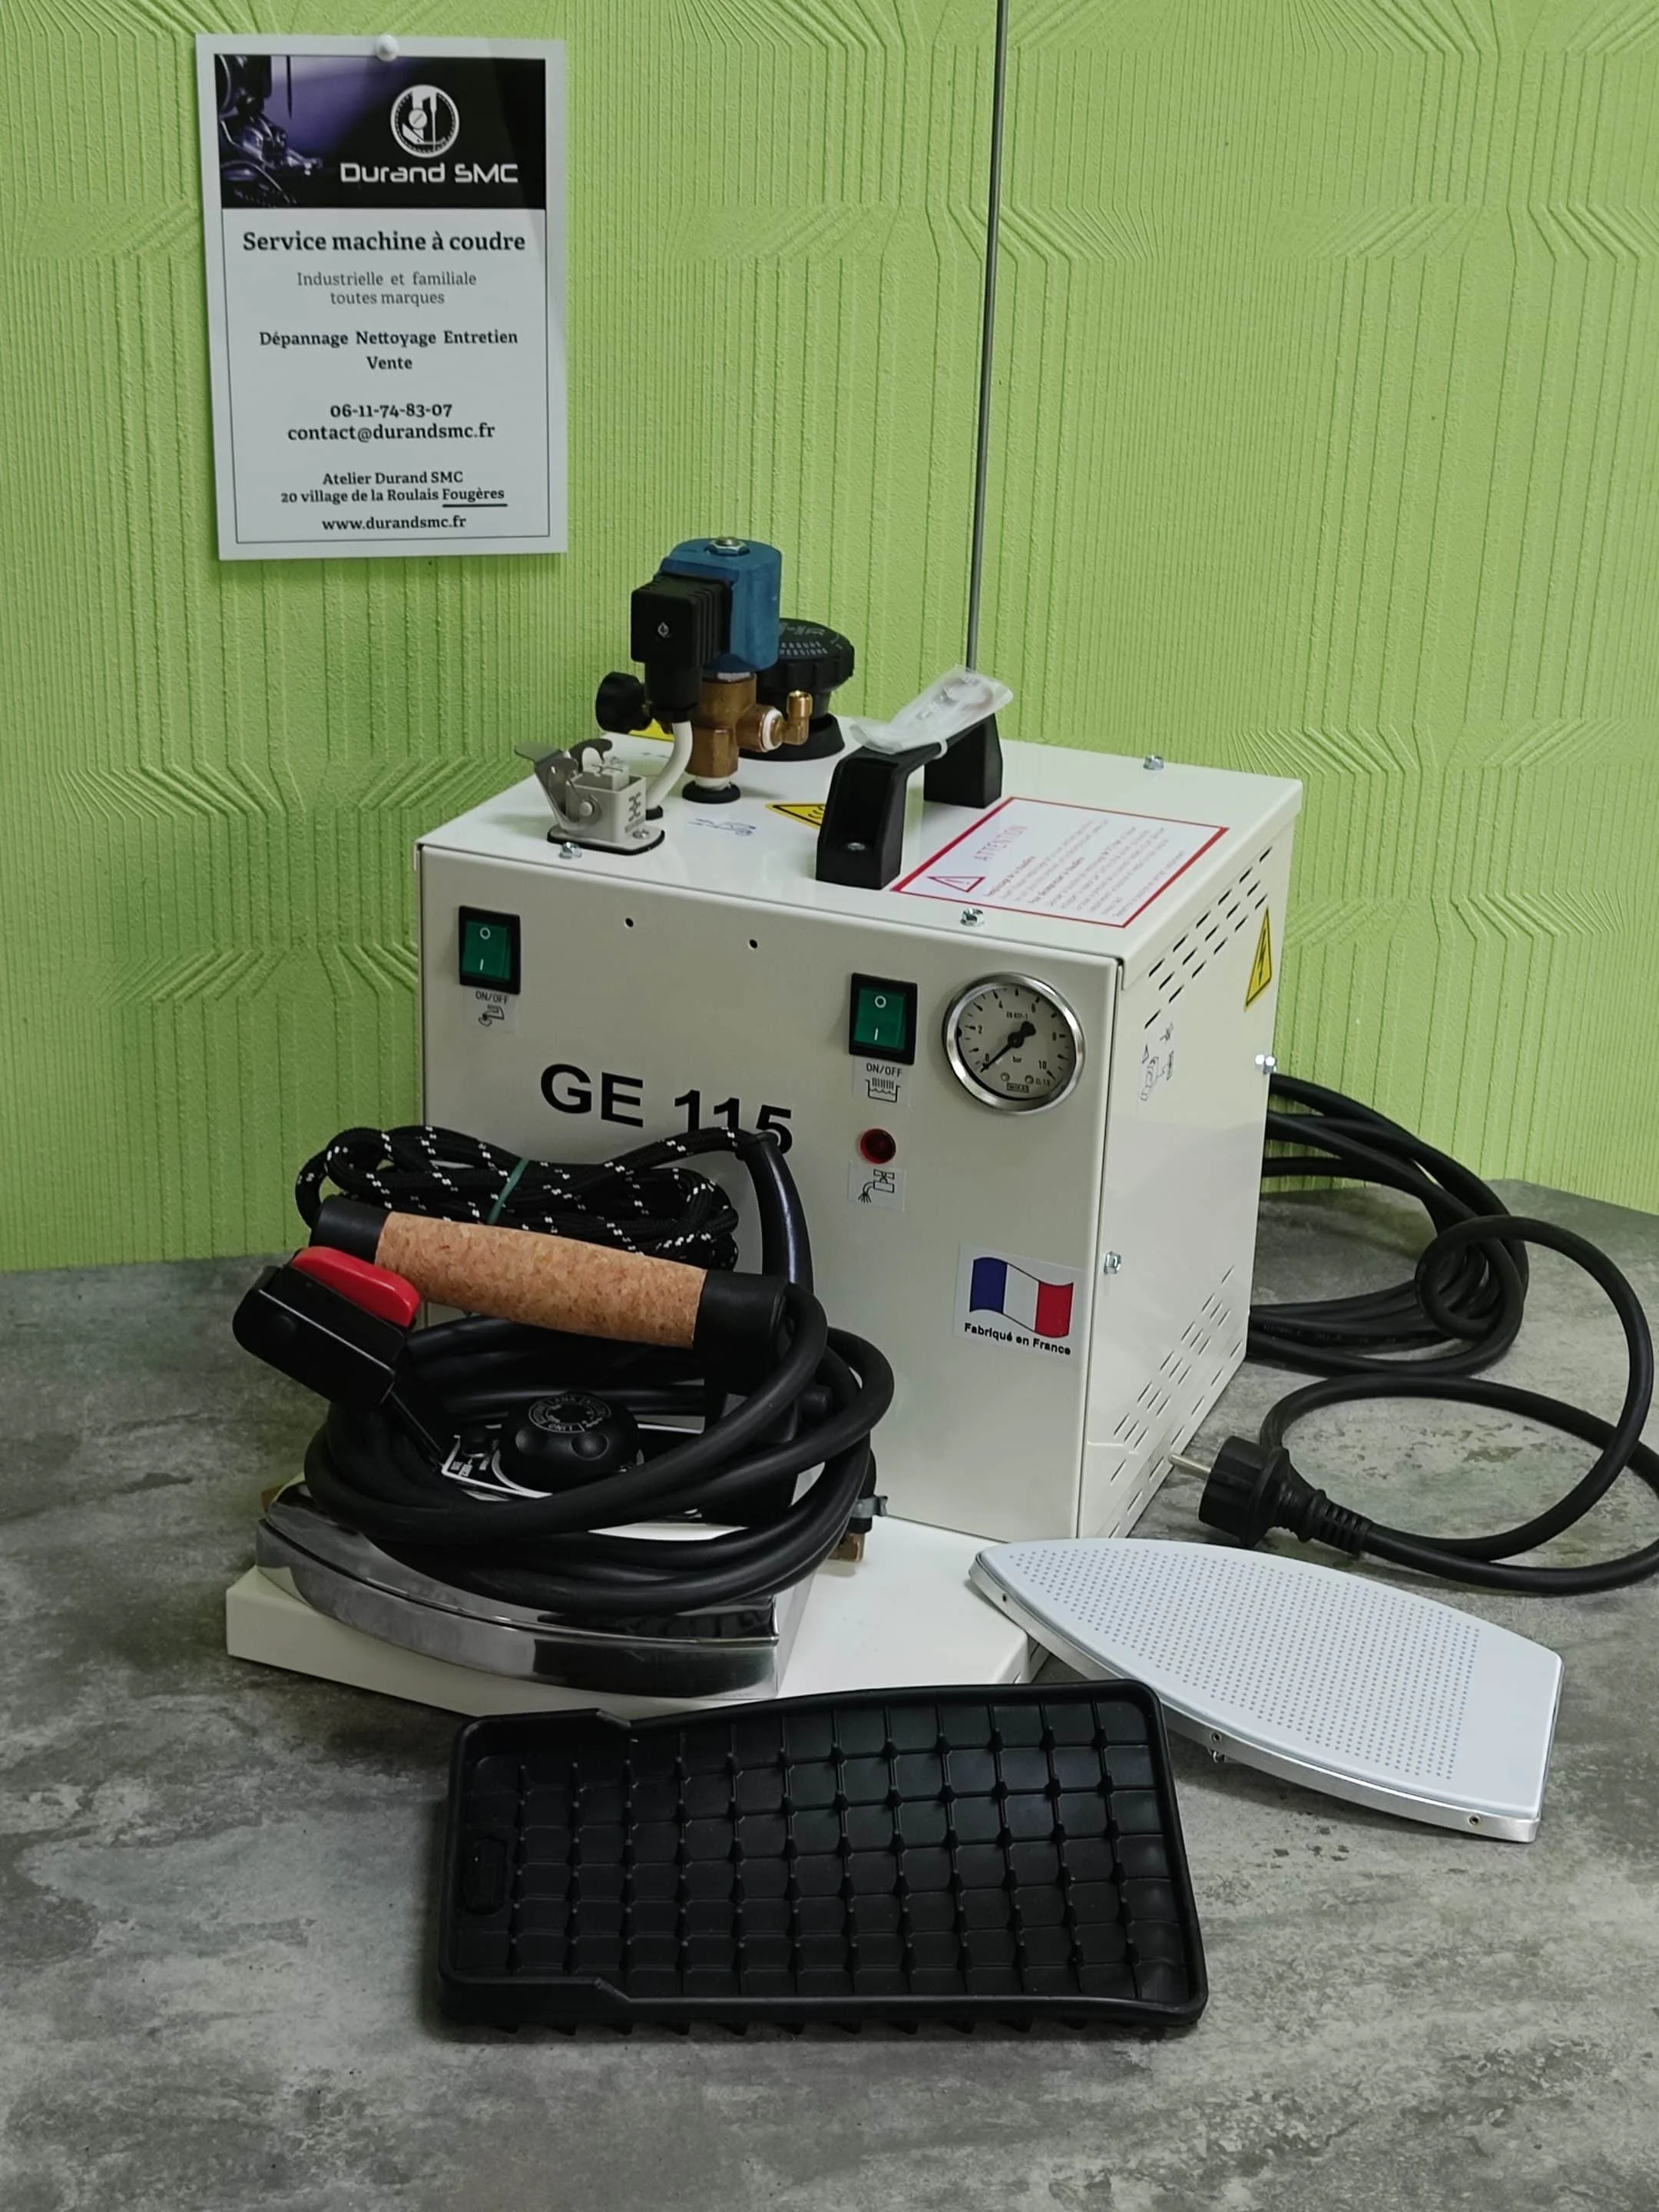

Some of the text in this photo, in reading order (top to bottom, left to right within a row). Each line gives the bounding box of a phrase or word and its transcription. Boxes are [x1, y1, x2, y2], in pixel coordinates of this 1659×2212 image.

[341, 164, 518, 182] Durand SMC
[243, 230, 525, 250] Service machine à coudre
[298, 271, 476, 286] Industrielle et familiale
[330, 293, 445, 307] toutes marques
[260, 329, 518, 349] Dépannage Nettoyage Entretien
[366, 356, 412, 369] Vente
[330, 403, 452, 418] 06-11-74-83-07
[288, 422, 495, 442] contact@durandsmc.fr
[323, 472, 462, 485] Atelier Durand SMC
[281, 487, 504, 505] 20 village de la Roulais Fougères
[322, 515, 466, 530] www.durandsmc.fr
[973, 823, 1028, 862] ATTENTION
[475, 990, 508, 1005] ON/OFF
[978, 1025, 983, 1035] 2
[866, 1062, 902, 1078] ON/OFF
[1038, 1060, 1047, 1070] 10
[541, 1063, 793, 1155] GE 115
[964, 1323, 1071, 1356] Fabriqué en France
